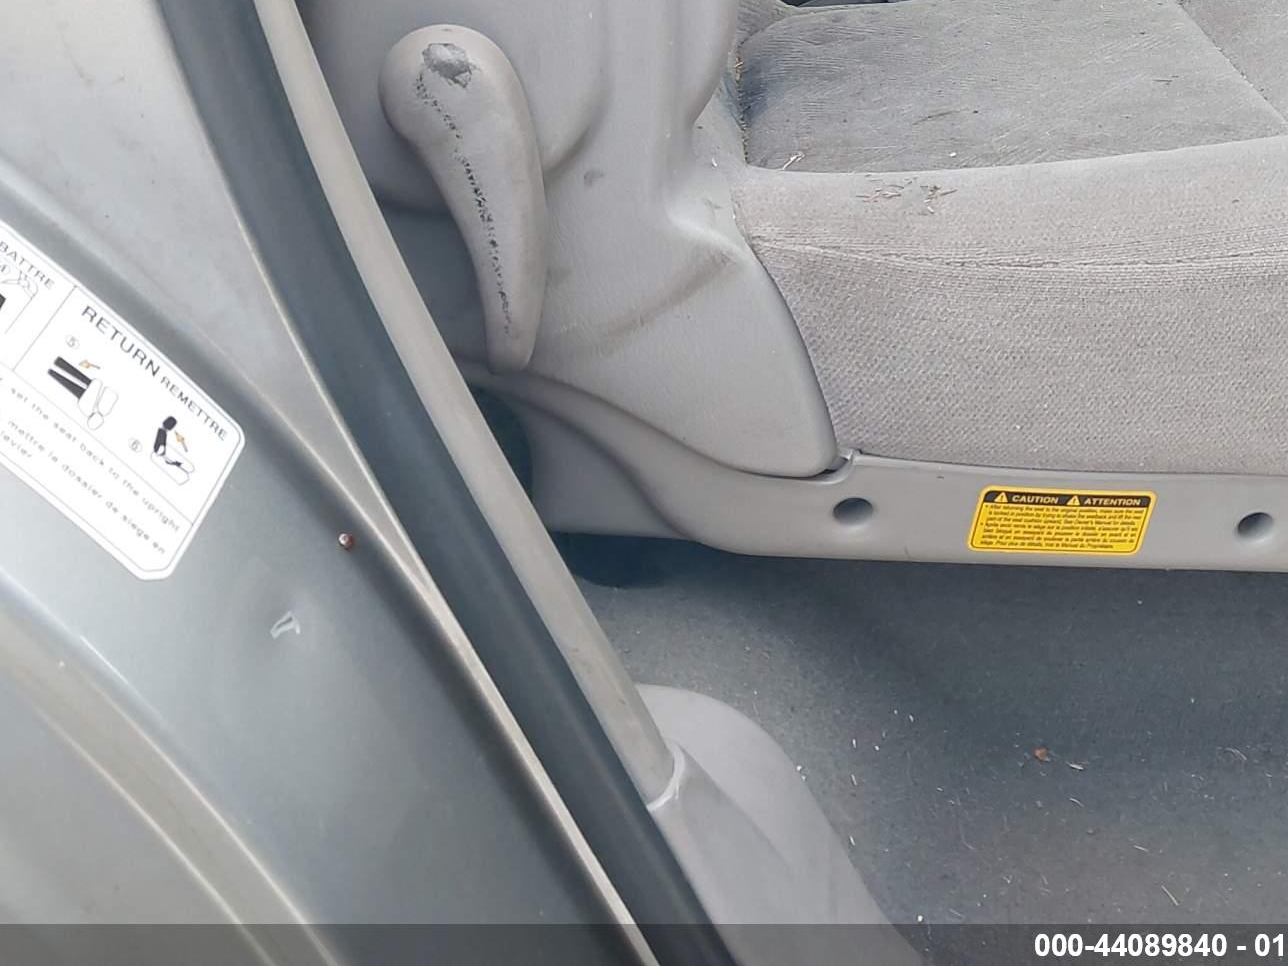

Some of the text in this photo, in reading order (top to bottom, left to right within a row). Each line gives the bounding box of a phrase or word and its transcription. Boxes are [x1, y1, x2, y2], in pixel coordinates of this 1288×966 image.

[81, 305, 228, 441] RETURN REMETTRE
[80, 442, 104, 466] back
[1012, 494, 1142, 507] CAUTION ATTENTION
